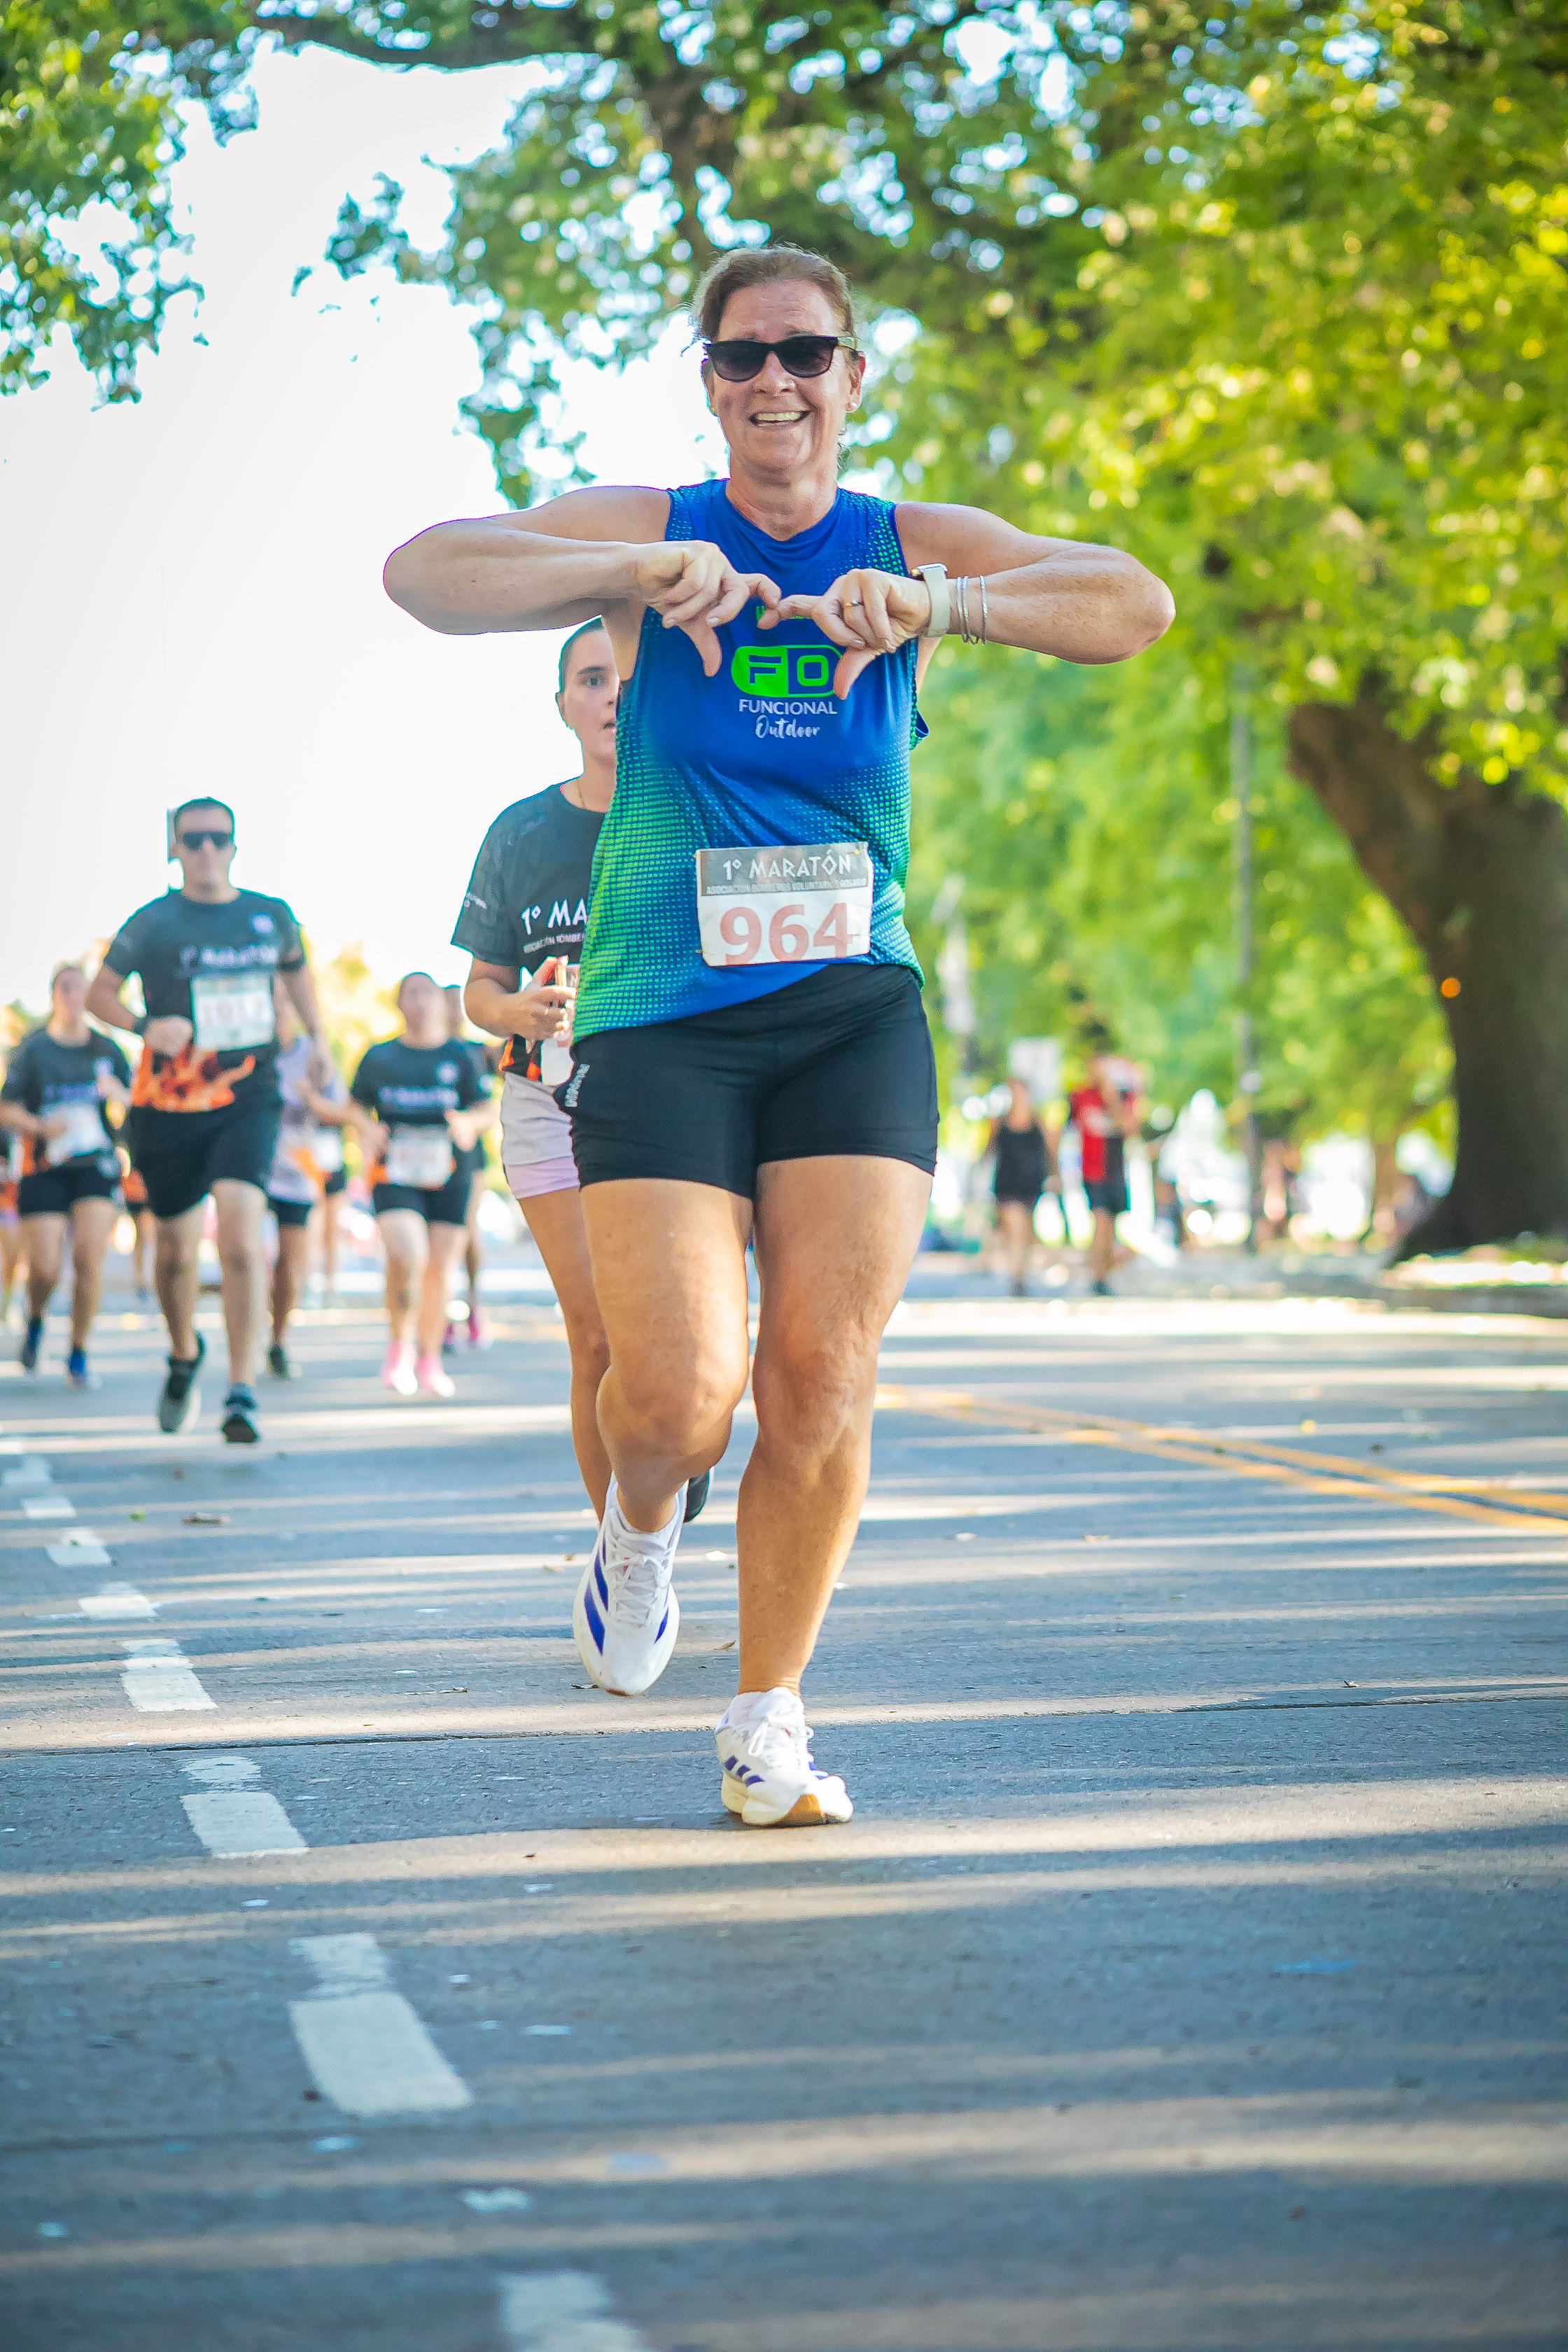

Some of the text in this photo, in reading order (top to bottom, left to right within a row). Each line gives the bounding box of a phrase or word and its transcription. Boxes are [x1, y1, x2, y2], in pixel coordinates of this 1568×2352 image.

[738, 699, 837, 715] FUNCIONAL
[755, 715, 821, 739] Outdoor
[748, 849, 851, 879] MARATÓN
[719, 902, 853, 966] 964
